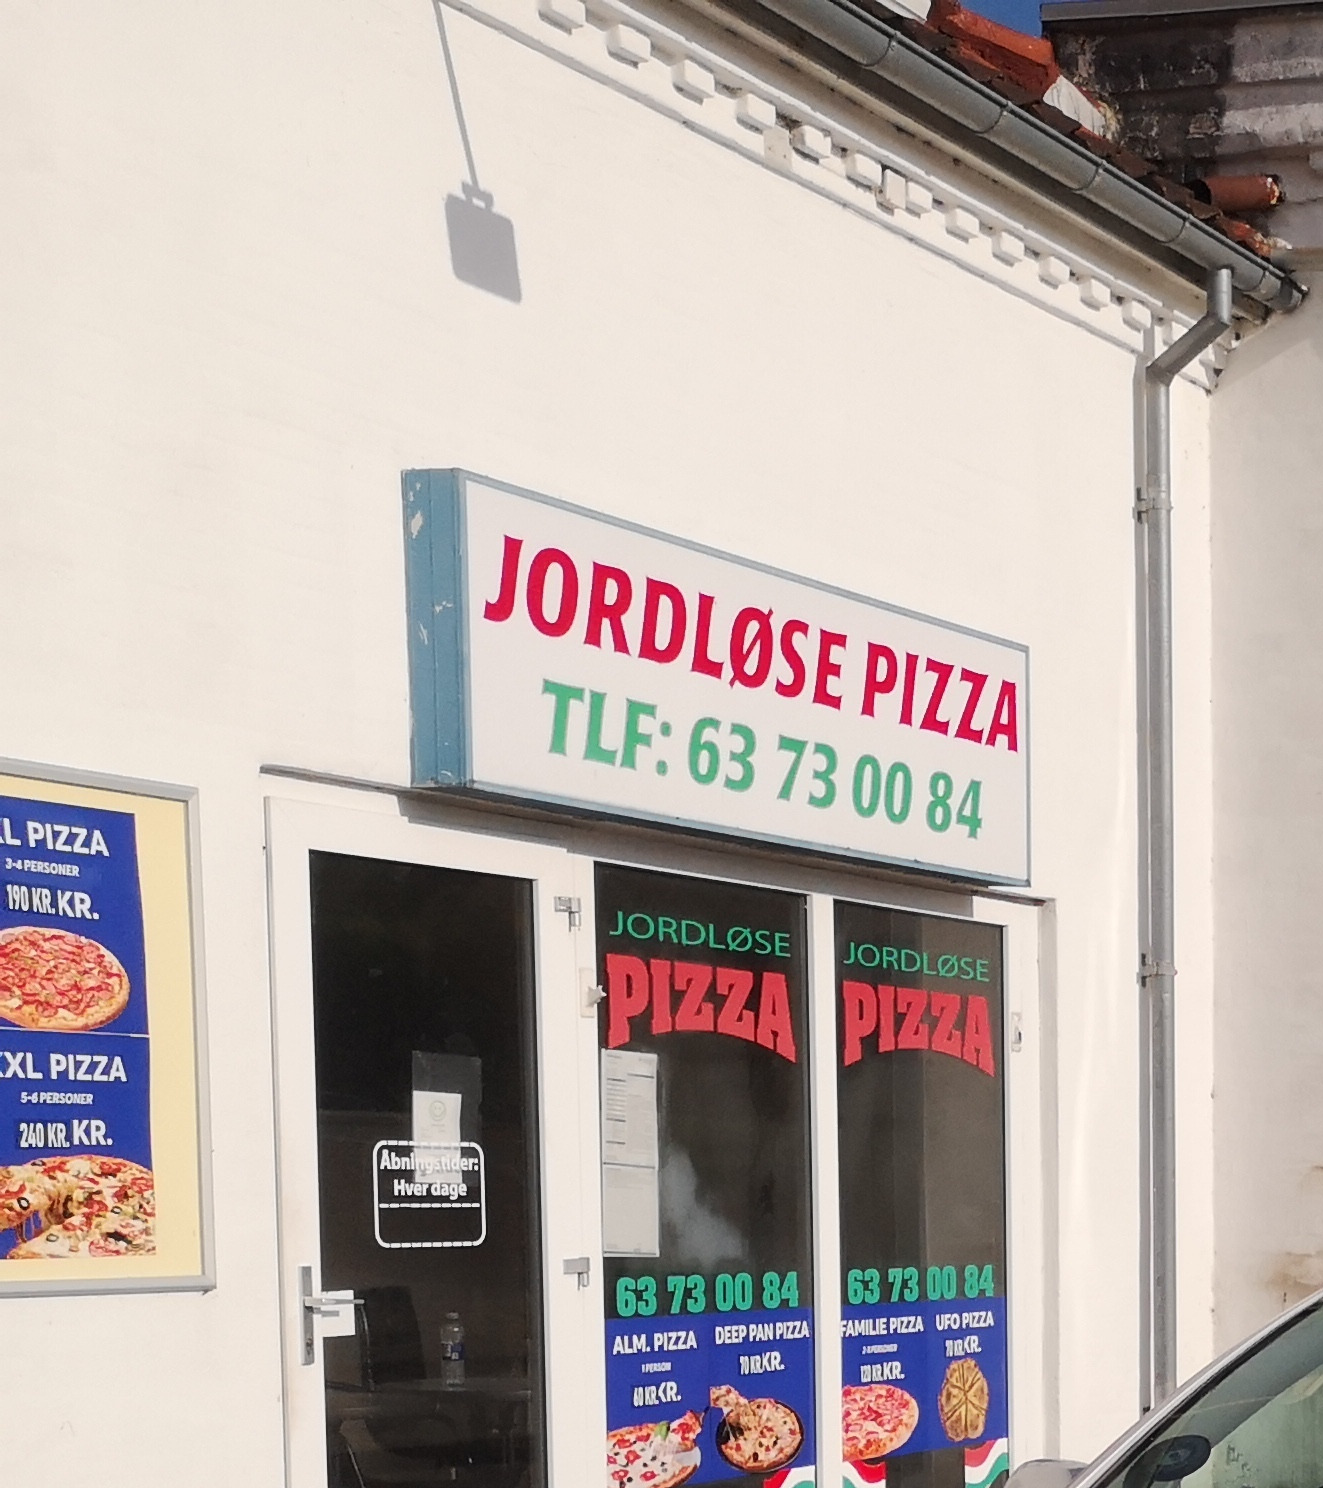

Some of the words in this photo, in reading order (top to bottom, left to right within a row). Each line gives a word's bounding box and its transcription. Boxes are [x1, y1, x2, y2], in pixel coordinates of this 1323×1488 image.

[483, 535, 848, 711] JORDLØSE
[859, 641, 1020, 754] PIZZA
[542, 678, 673, 777] TLF:
[688, 716, 756, 793] 63
[777, 734, 838, 809] 73
[852, 754, 913, 825] 00
[926, 771, 984, 840] 84
[0, 817, 22, 846] L
[26, 820, 110, 857] PIZZA
[23, 859, 80, 877] PERSONER
[6, 884, 29, 912] 190
[31, 887, 56, 914] KR.
[57, 890, 100, 920] KR.
[609, 910, 792, 958] JORDLØSE
[843, 941, 991, 982] JORDLØSE
[605, 953, 797, 1064] PIZZA
[842, 980, 995, 1077] PIZZA
[0, 1051, 43, 1080] XL
[49, 1053, 128, 1082] PIZZA
[40, 1091, 94, 1105] PERSONER
[19, 1122, 45, 1148] 240
[47, 1122, 70, 1148] KR.
[72, 1119, 114, 1146] KR.
[393, 1178, 430, 1197] Hver
[430, 1181, 468, 1201] dage
[616, 1275, 658, 1317] 63
[667, 1274, 706, 1314] 73
[715, 1272, 753, 1312] 00
[762, 1271, 800, 1309] 84
[847, 1268, 881, 1304] 63
[887, 1266, 920, 1301] 73
[926, 1265, 957, 1300] 00
[964, 1264, 995, 1298] 84
[714, 1324, 747, 1345] DEEP
[748, 1322, 774, 1342] PAN
[775, 1320, 811, 1340] PIZZA
[840, 1317, 888, 1338] FAMILIE
[889, 1315, 924, 1334] PIZZA
[935, 1313, 961, 1331] UFO
[961, 1311, 995, 1329] PIZZA
[613, 1333, 651, 1355] ALM.
[653, 1330, 698, 1352] PIZZA
